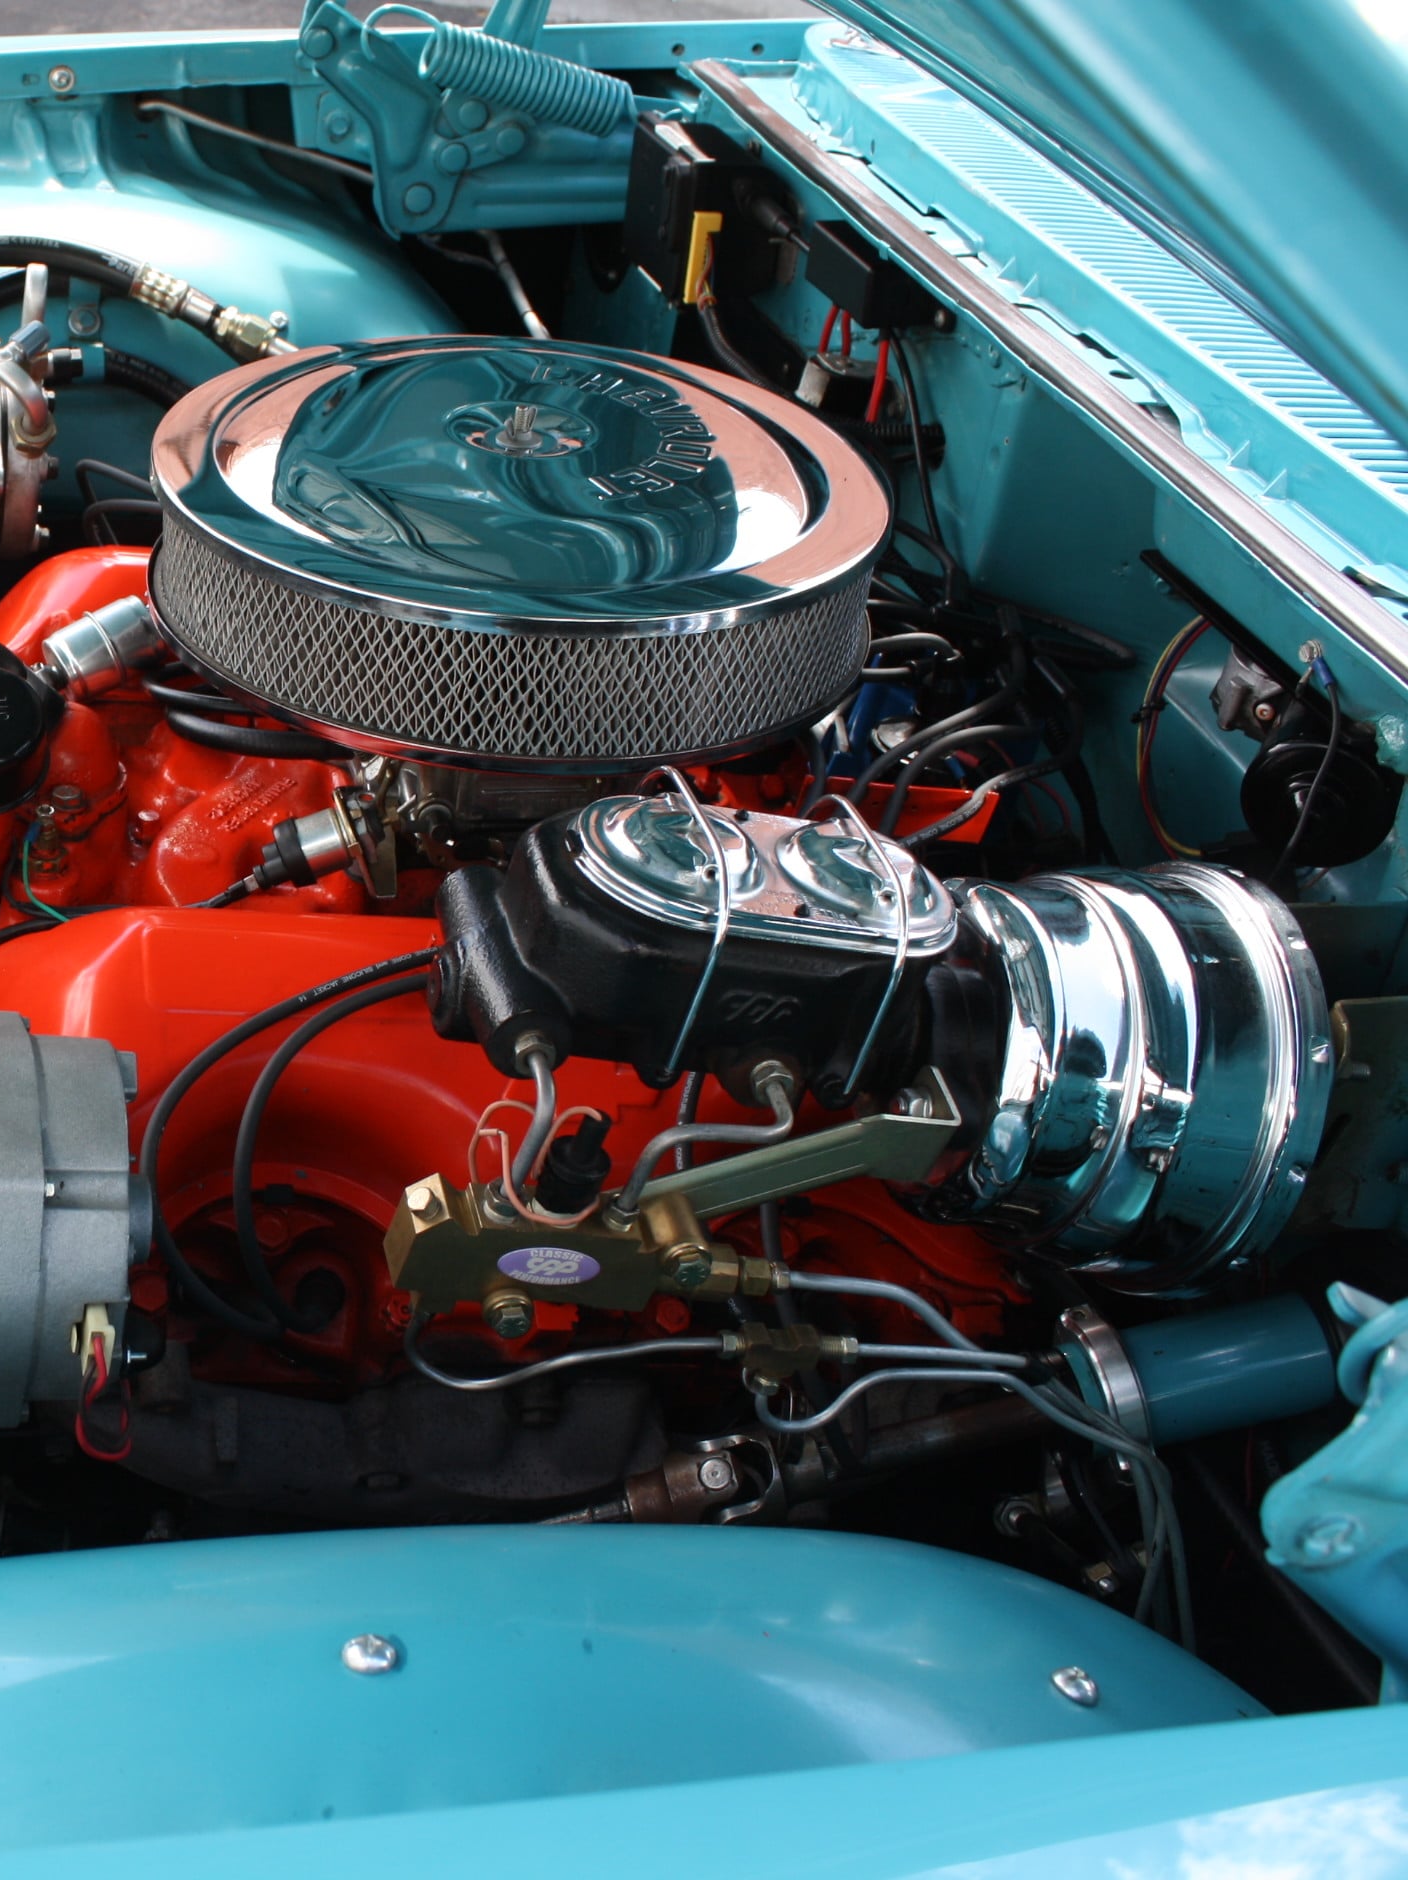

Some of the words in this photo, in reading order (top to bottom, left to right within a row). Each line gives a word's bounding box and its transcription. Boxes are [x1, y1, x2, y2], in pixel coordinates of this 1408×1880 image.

[341, 965, 374, 983] SILICONE
[312, 979, 339, 997] JACKET
[530, 1249, 584, 1262] CLASSIC
[508, 1270, 581, 1285] PERFORMANCE
